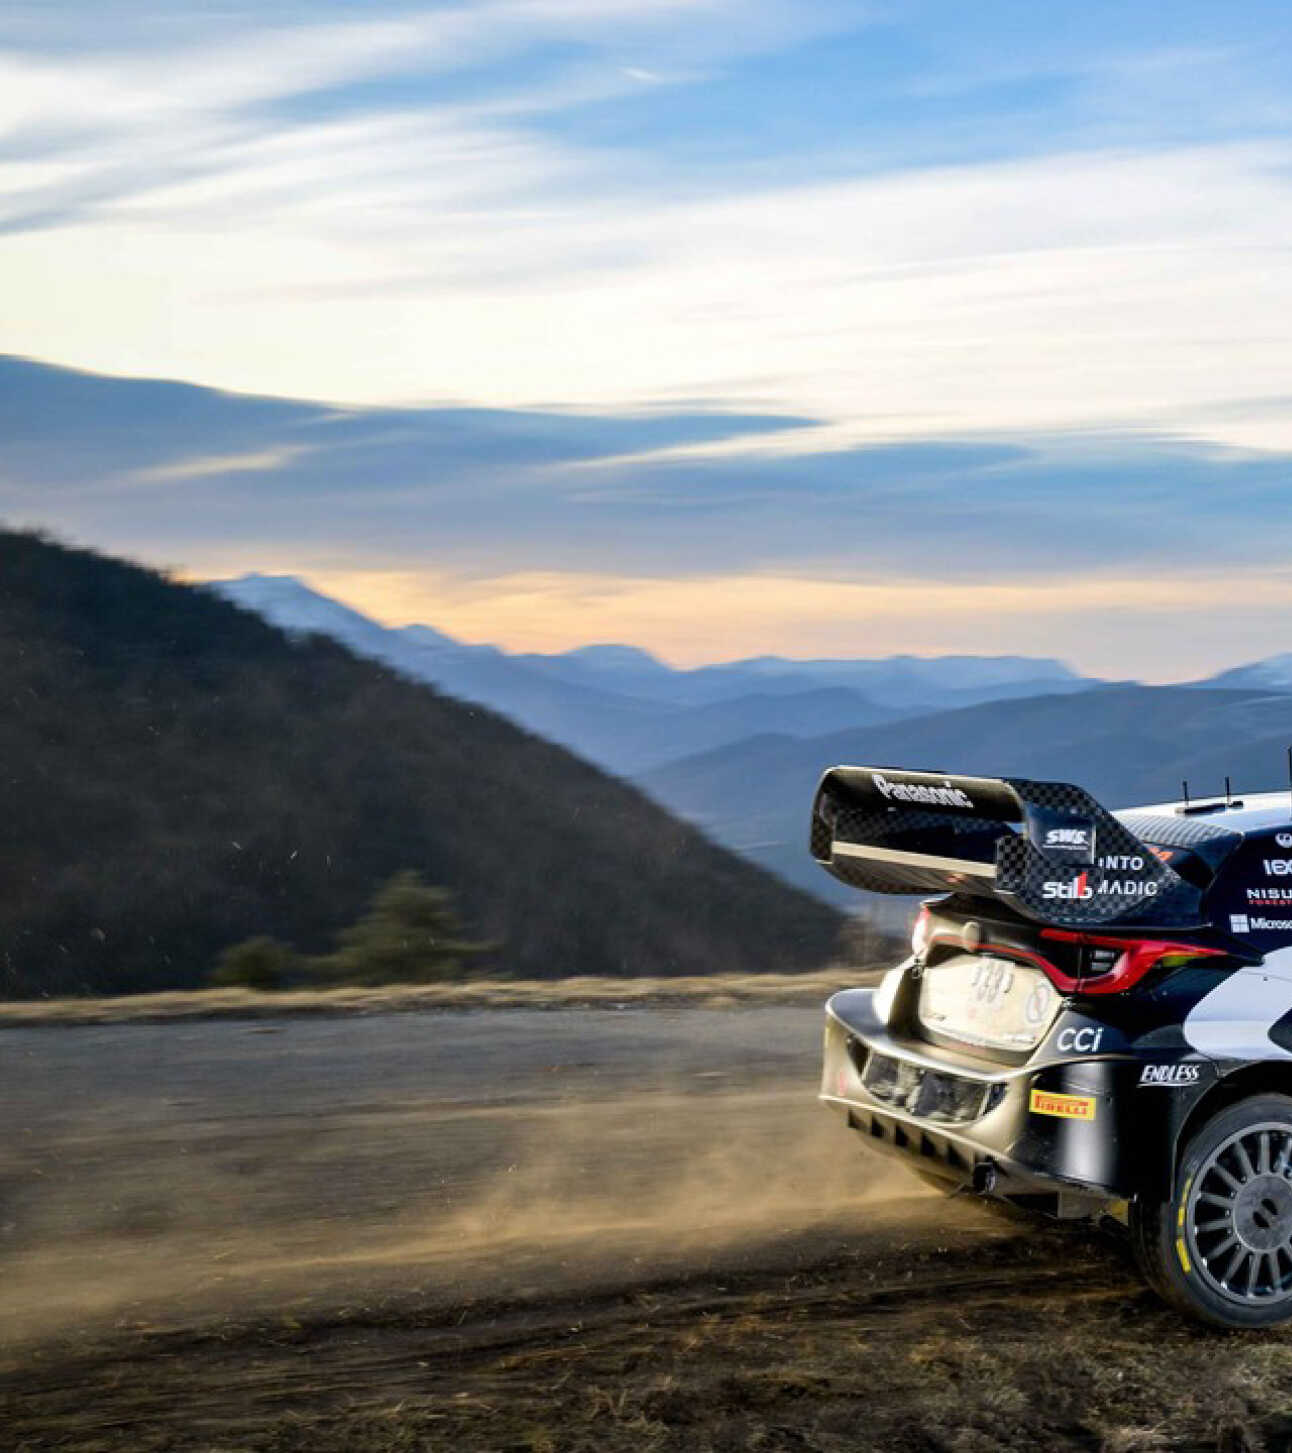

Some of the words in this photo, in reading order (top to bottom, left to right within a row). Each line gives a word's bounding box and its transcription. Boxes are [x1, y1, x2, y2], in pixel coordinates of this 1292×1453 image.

[872, 774, 974, 808] Panasonic
[1141, 1065, 1200, 1083] ENDLESS
[1033, 1095, 1090, 1115] PIRELLI
